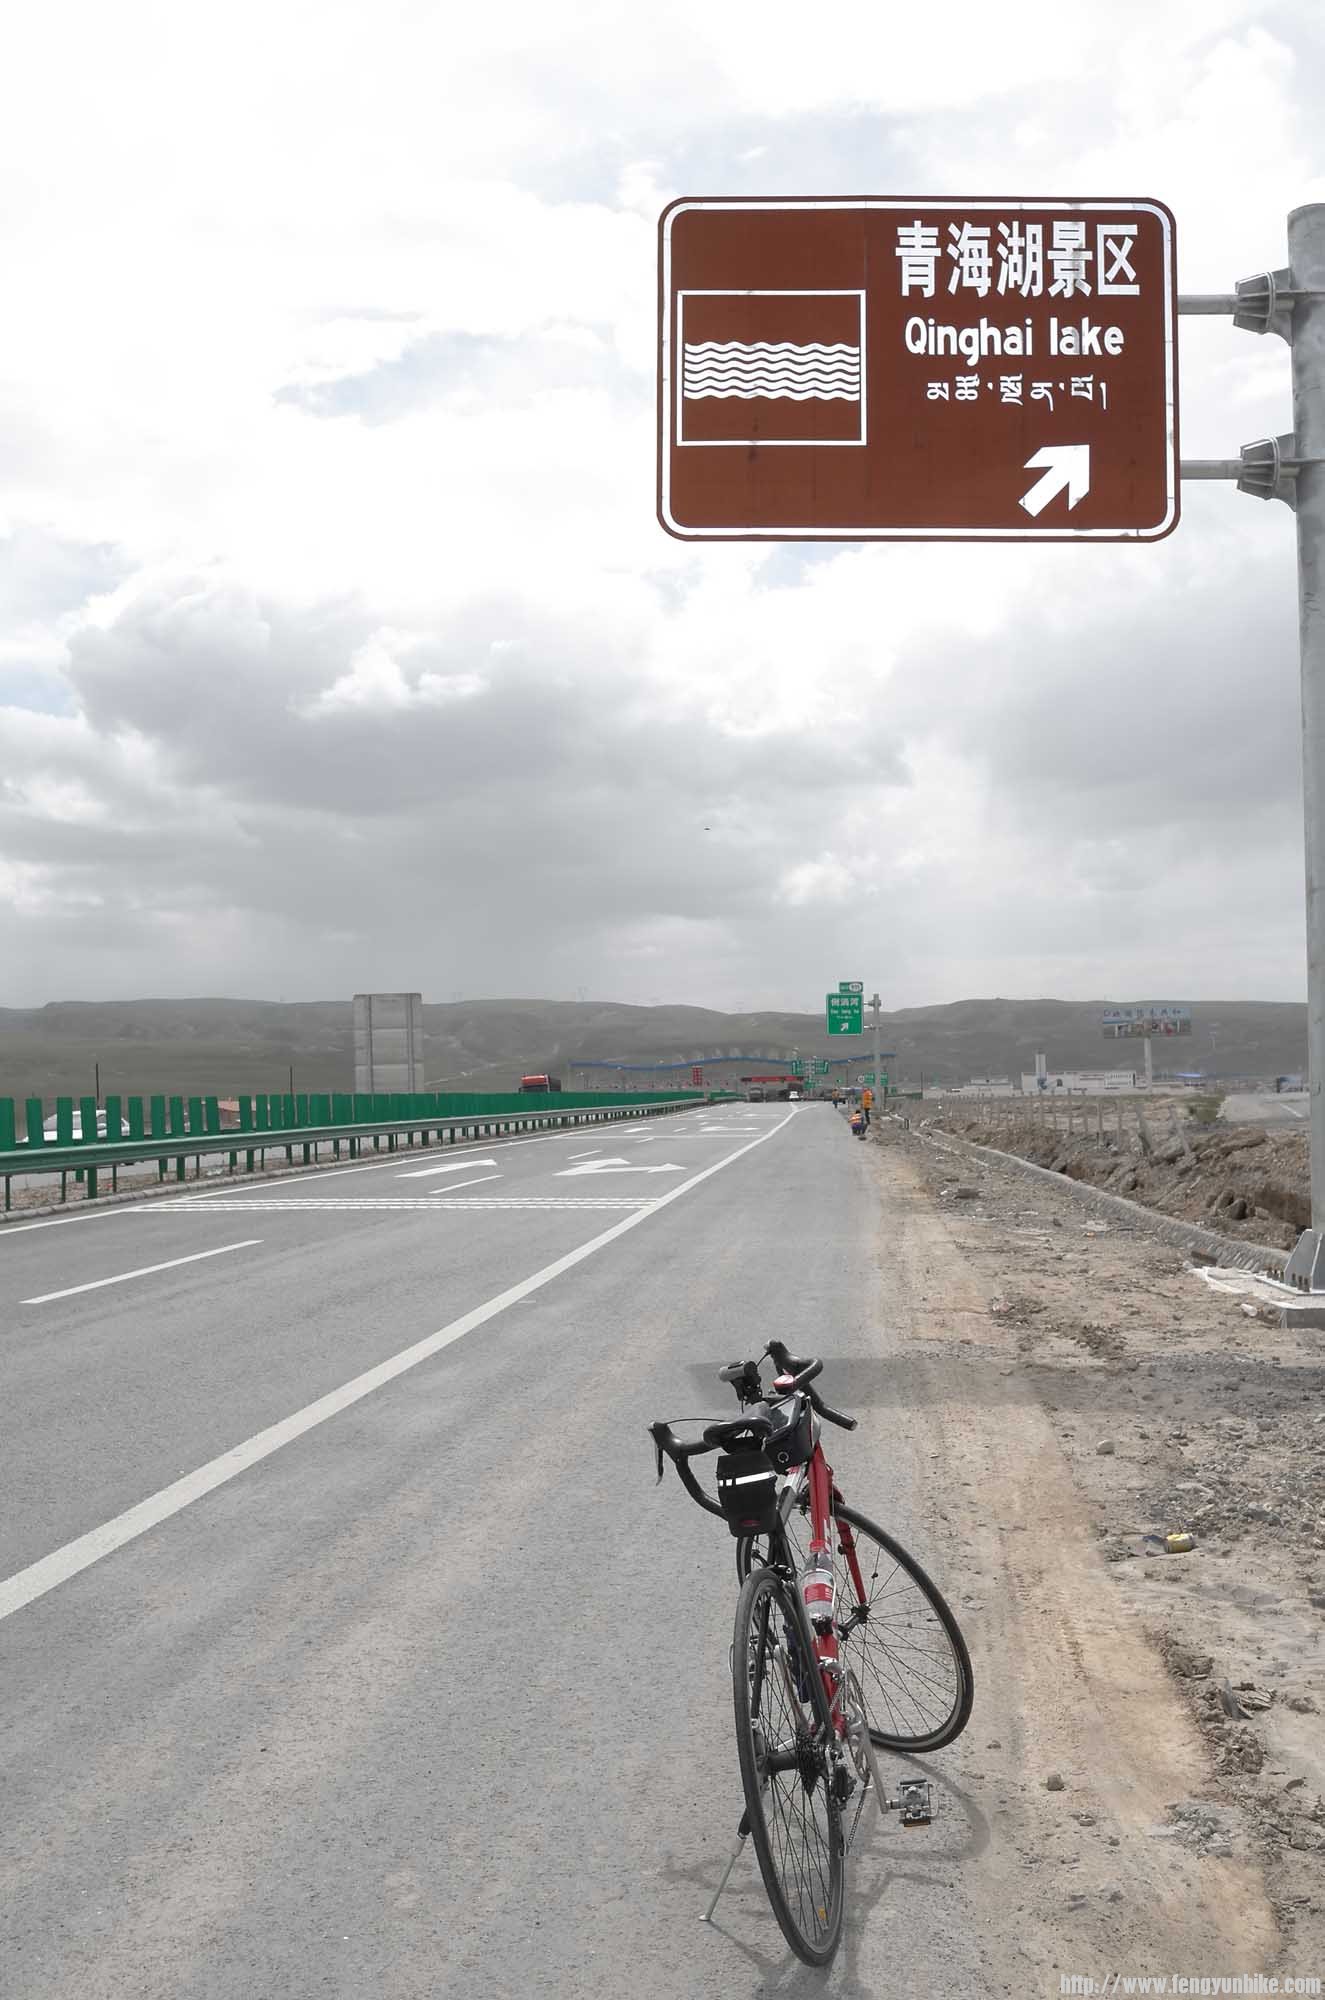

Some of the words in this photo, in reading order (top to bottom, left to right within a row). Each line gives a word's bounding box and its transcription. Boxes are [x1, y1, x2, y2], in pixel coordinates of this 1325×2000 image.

[895, 220, 1140, 298] 青海湖景区
[905, 317, 1032, 366] Qinghai
[1050, 317, 1124, 356] lake
